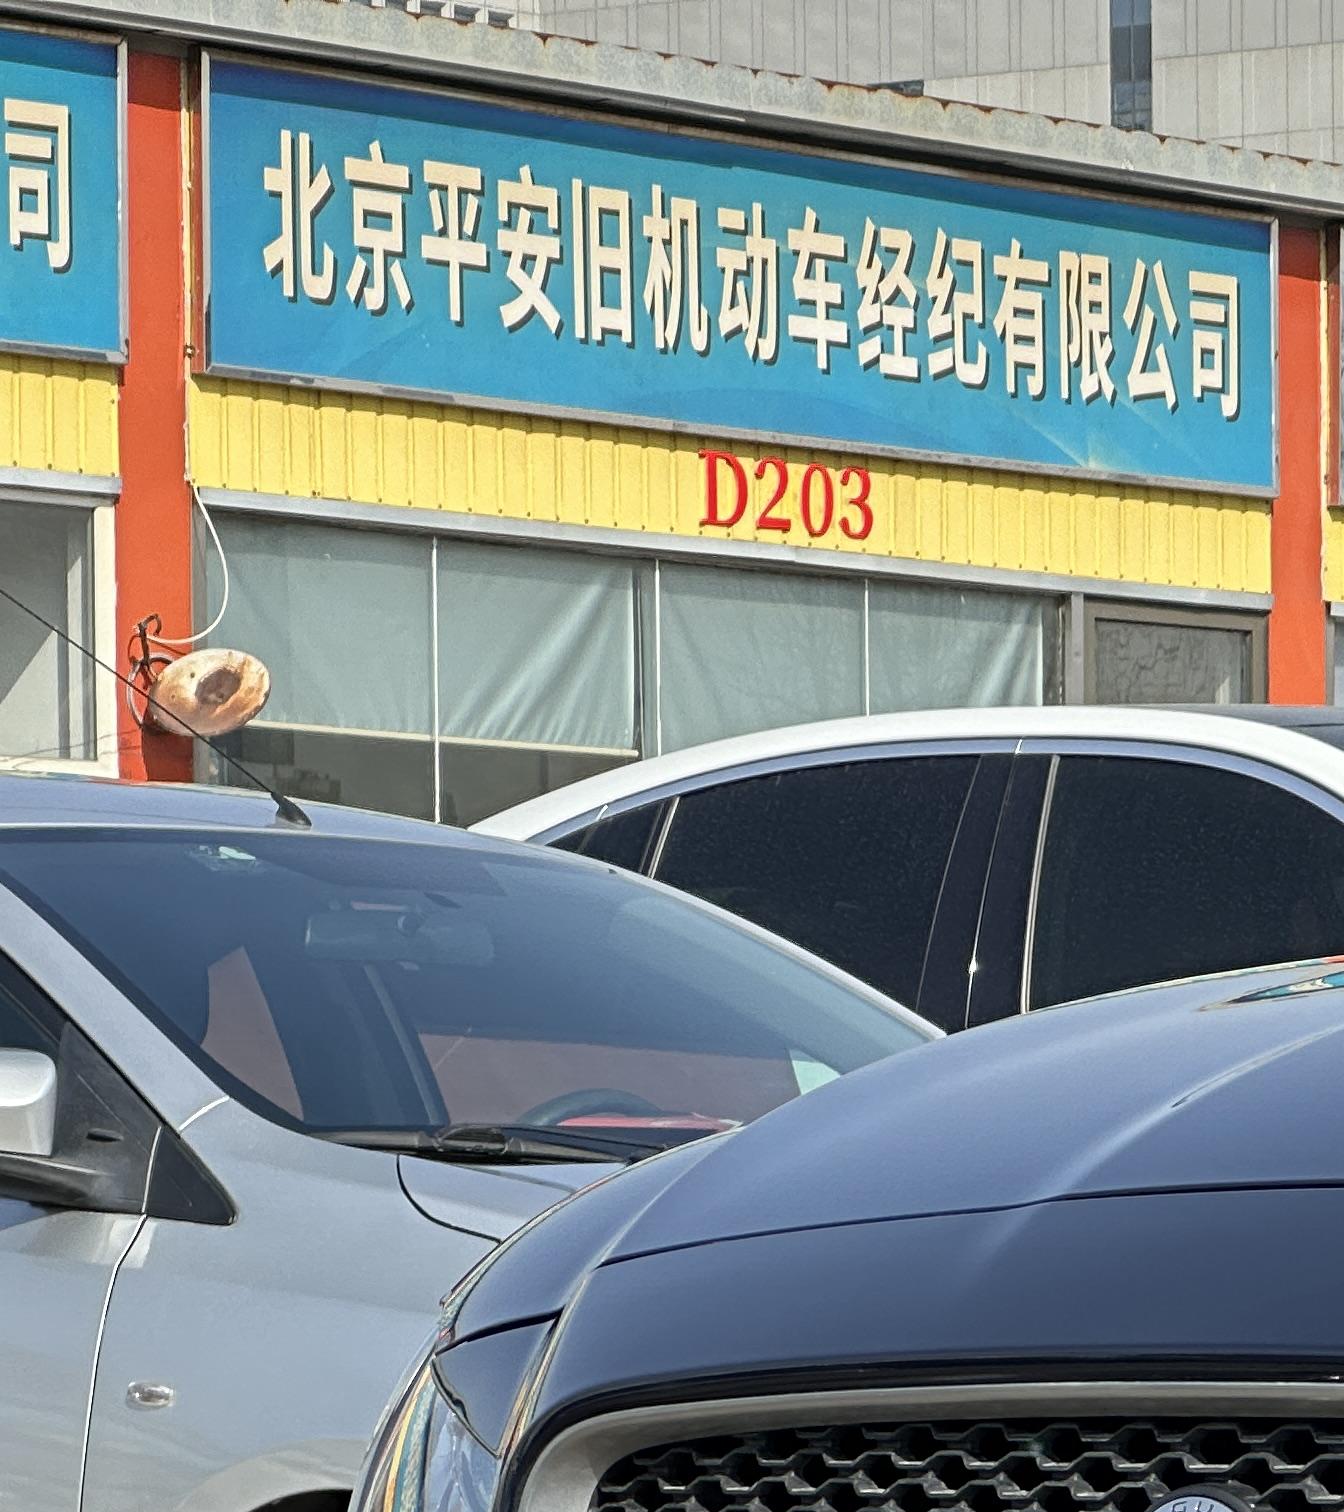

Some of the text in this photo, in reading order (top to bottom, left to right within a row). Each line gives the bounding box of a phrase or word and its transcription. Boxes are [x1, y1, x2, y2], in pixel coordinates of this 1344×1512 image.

[4, 98, 71, 271] 司
[262, 128, 1240, 420] 北京平安旧机动车经纪有限公司
[698, 448, 874, 540] D203
